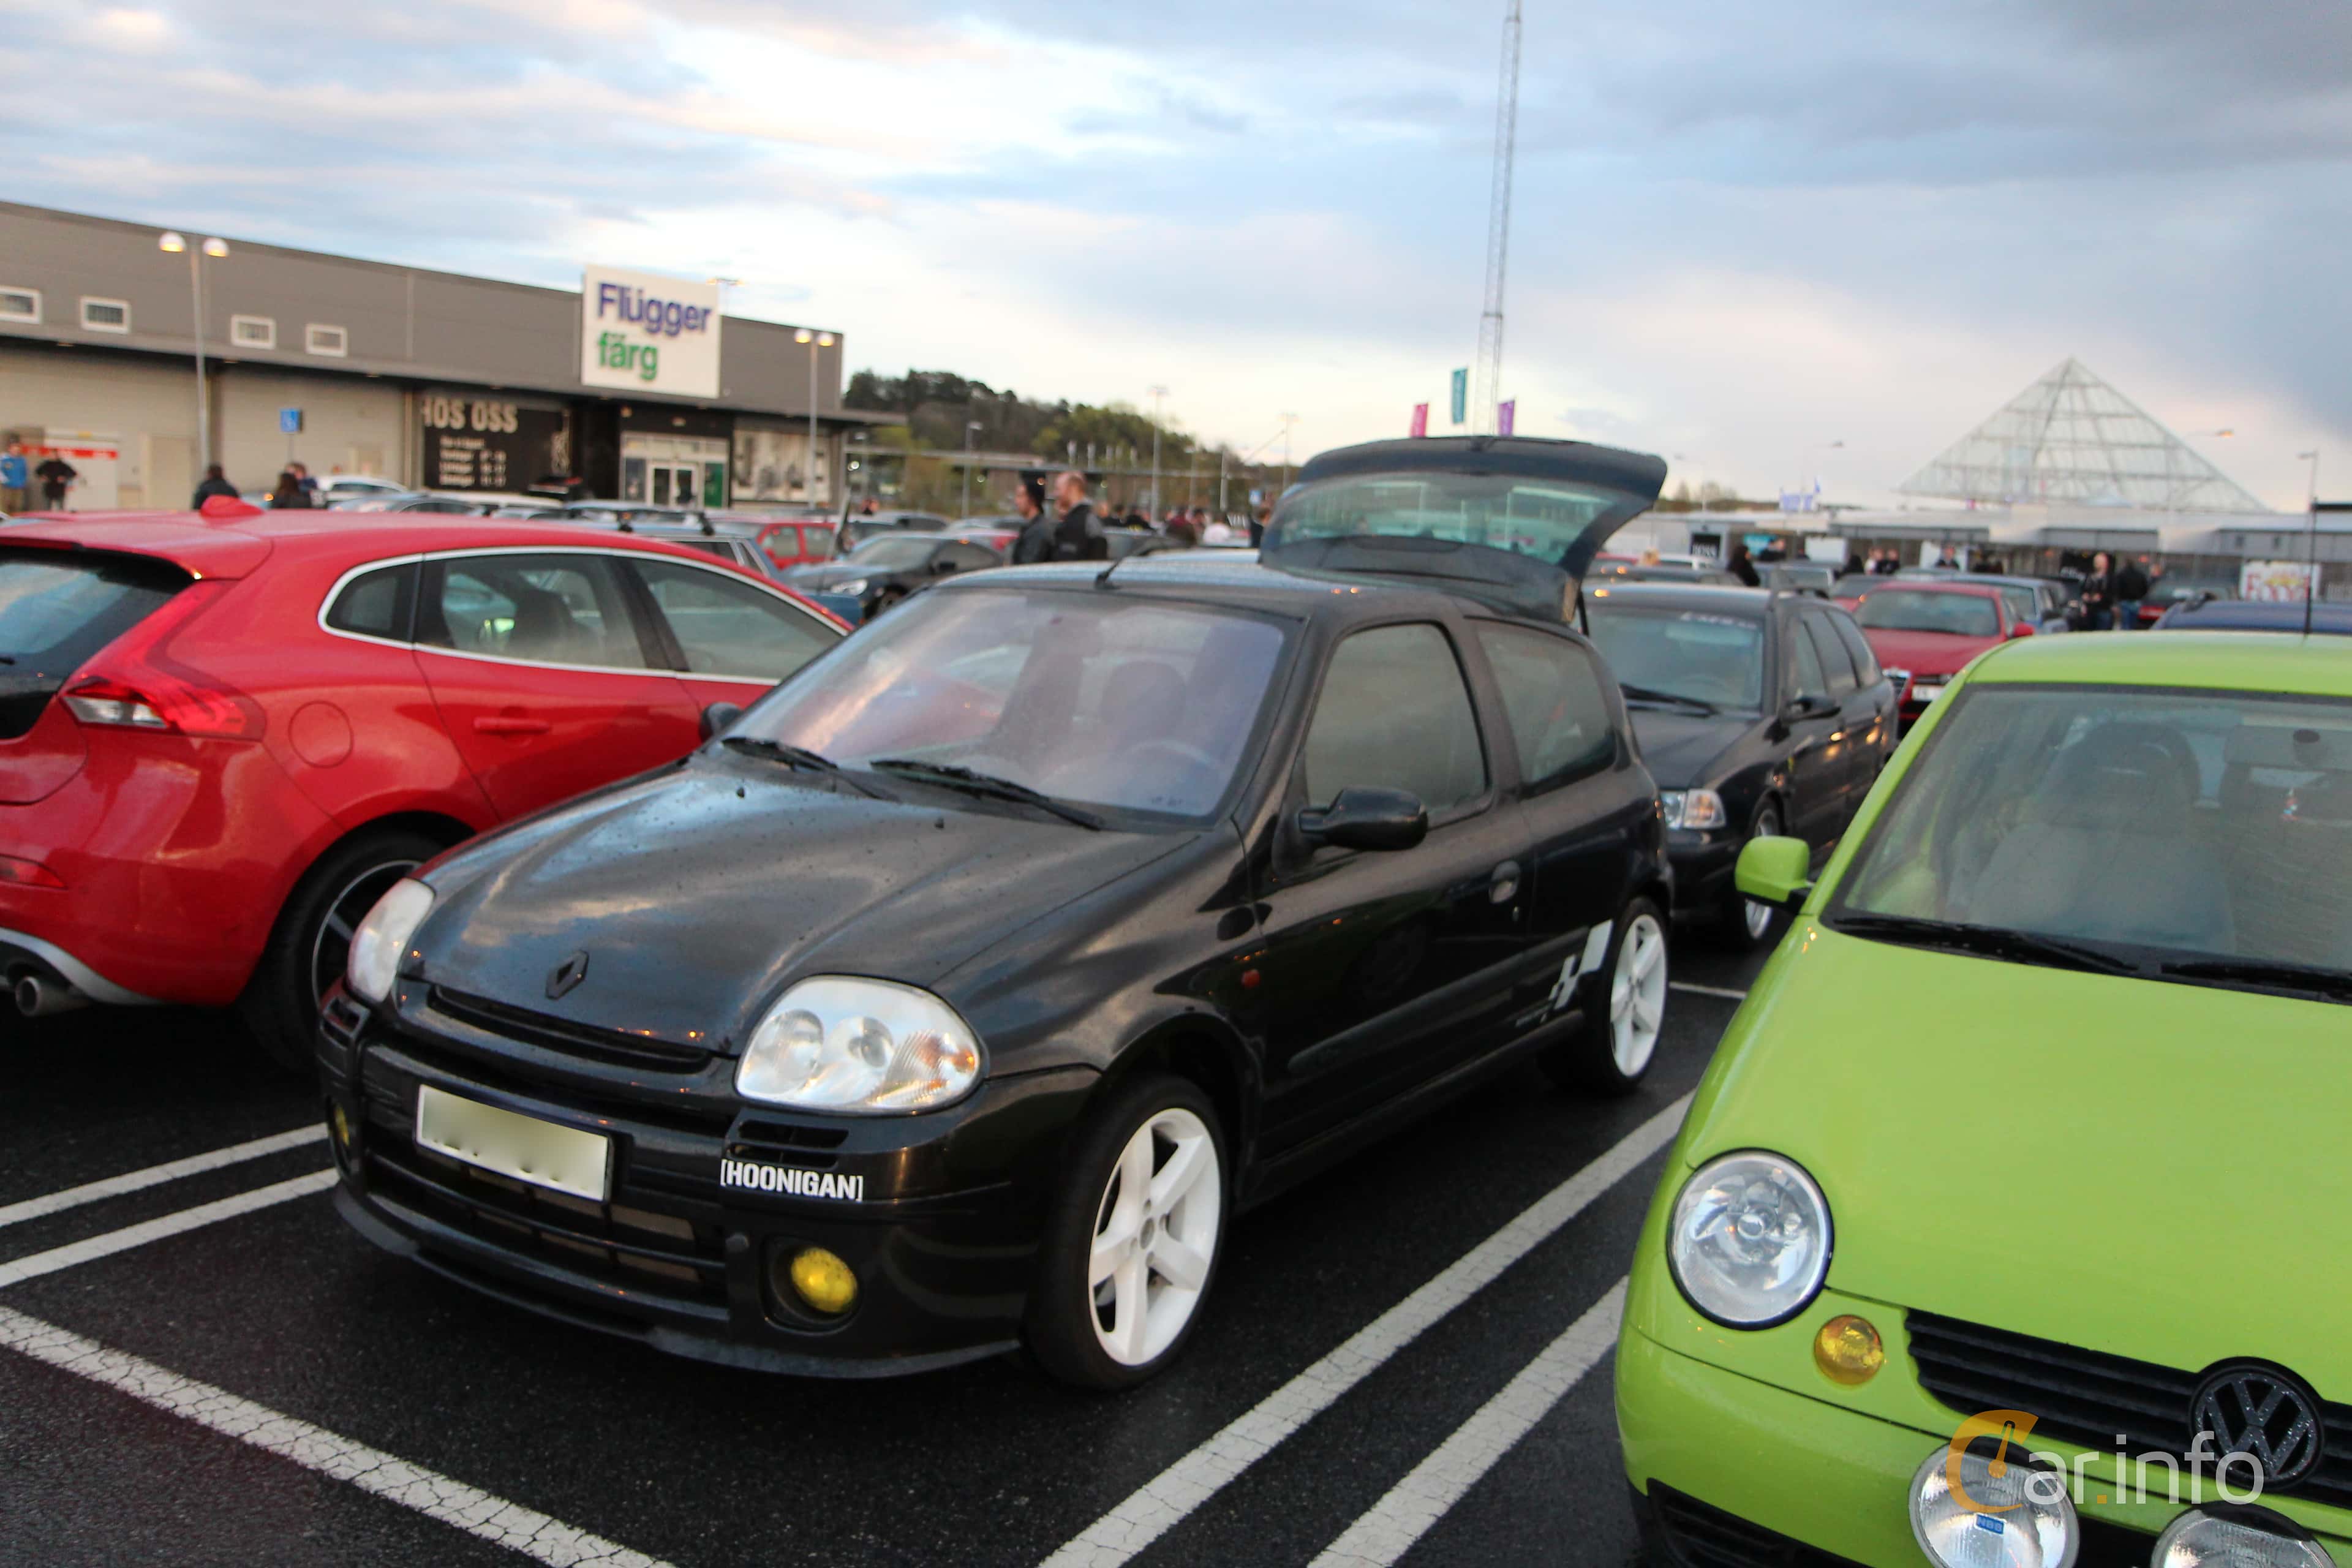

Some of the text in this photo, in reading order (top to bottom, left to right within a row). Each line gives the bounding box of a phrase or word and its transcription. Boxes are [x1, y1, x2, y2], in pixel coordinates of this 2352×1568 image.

[598, 282, 712, 336] Flügger
[598, 331, 658, 381] färg
[471, 400, 518, 434] OSS
